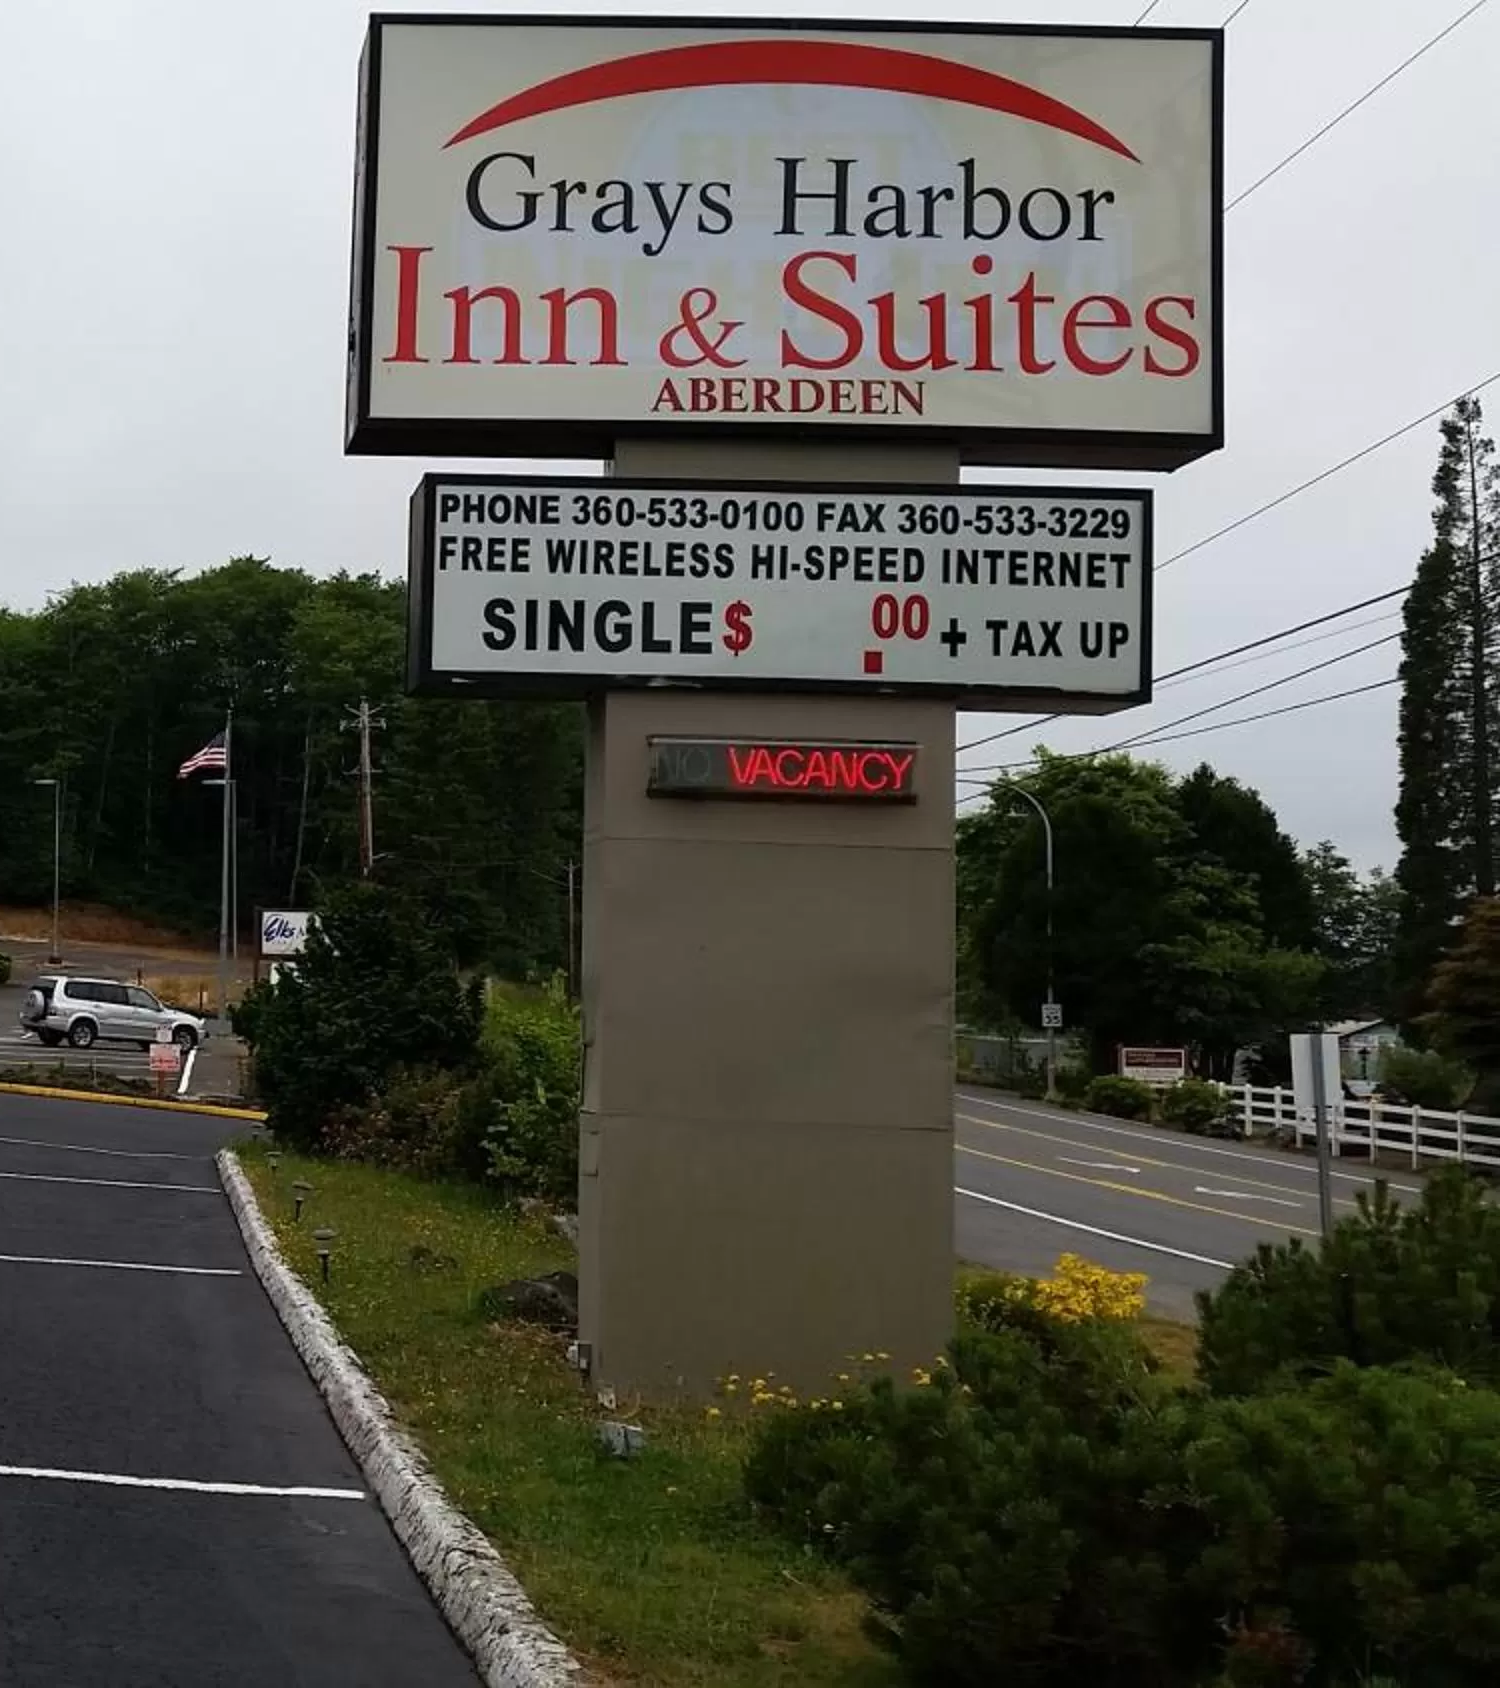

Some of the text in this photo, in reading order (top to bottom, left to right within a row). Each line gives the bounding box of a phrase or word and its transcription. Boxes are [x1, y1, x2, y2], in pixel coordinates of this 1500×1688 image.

[465, 151, 1115, 257] Grays Harbor
[382, 245, 1201, 378] Inn & Suites
[651, 377, 926, 417] ABERDEEN
[439, 494, 1132, 540] PHONE 360-533-0100 FAX 360-533-3229
[438, 535, 1132, 589] FREE WIRELESS HI-SPEED INTERNET
[985, 619, 1064, 658] TAX
[1079, 621, 1130, 659] UP
[656, 745, 913, 790] NO VACANCY
